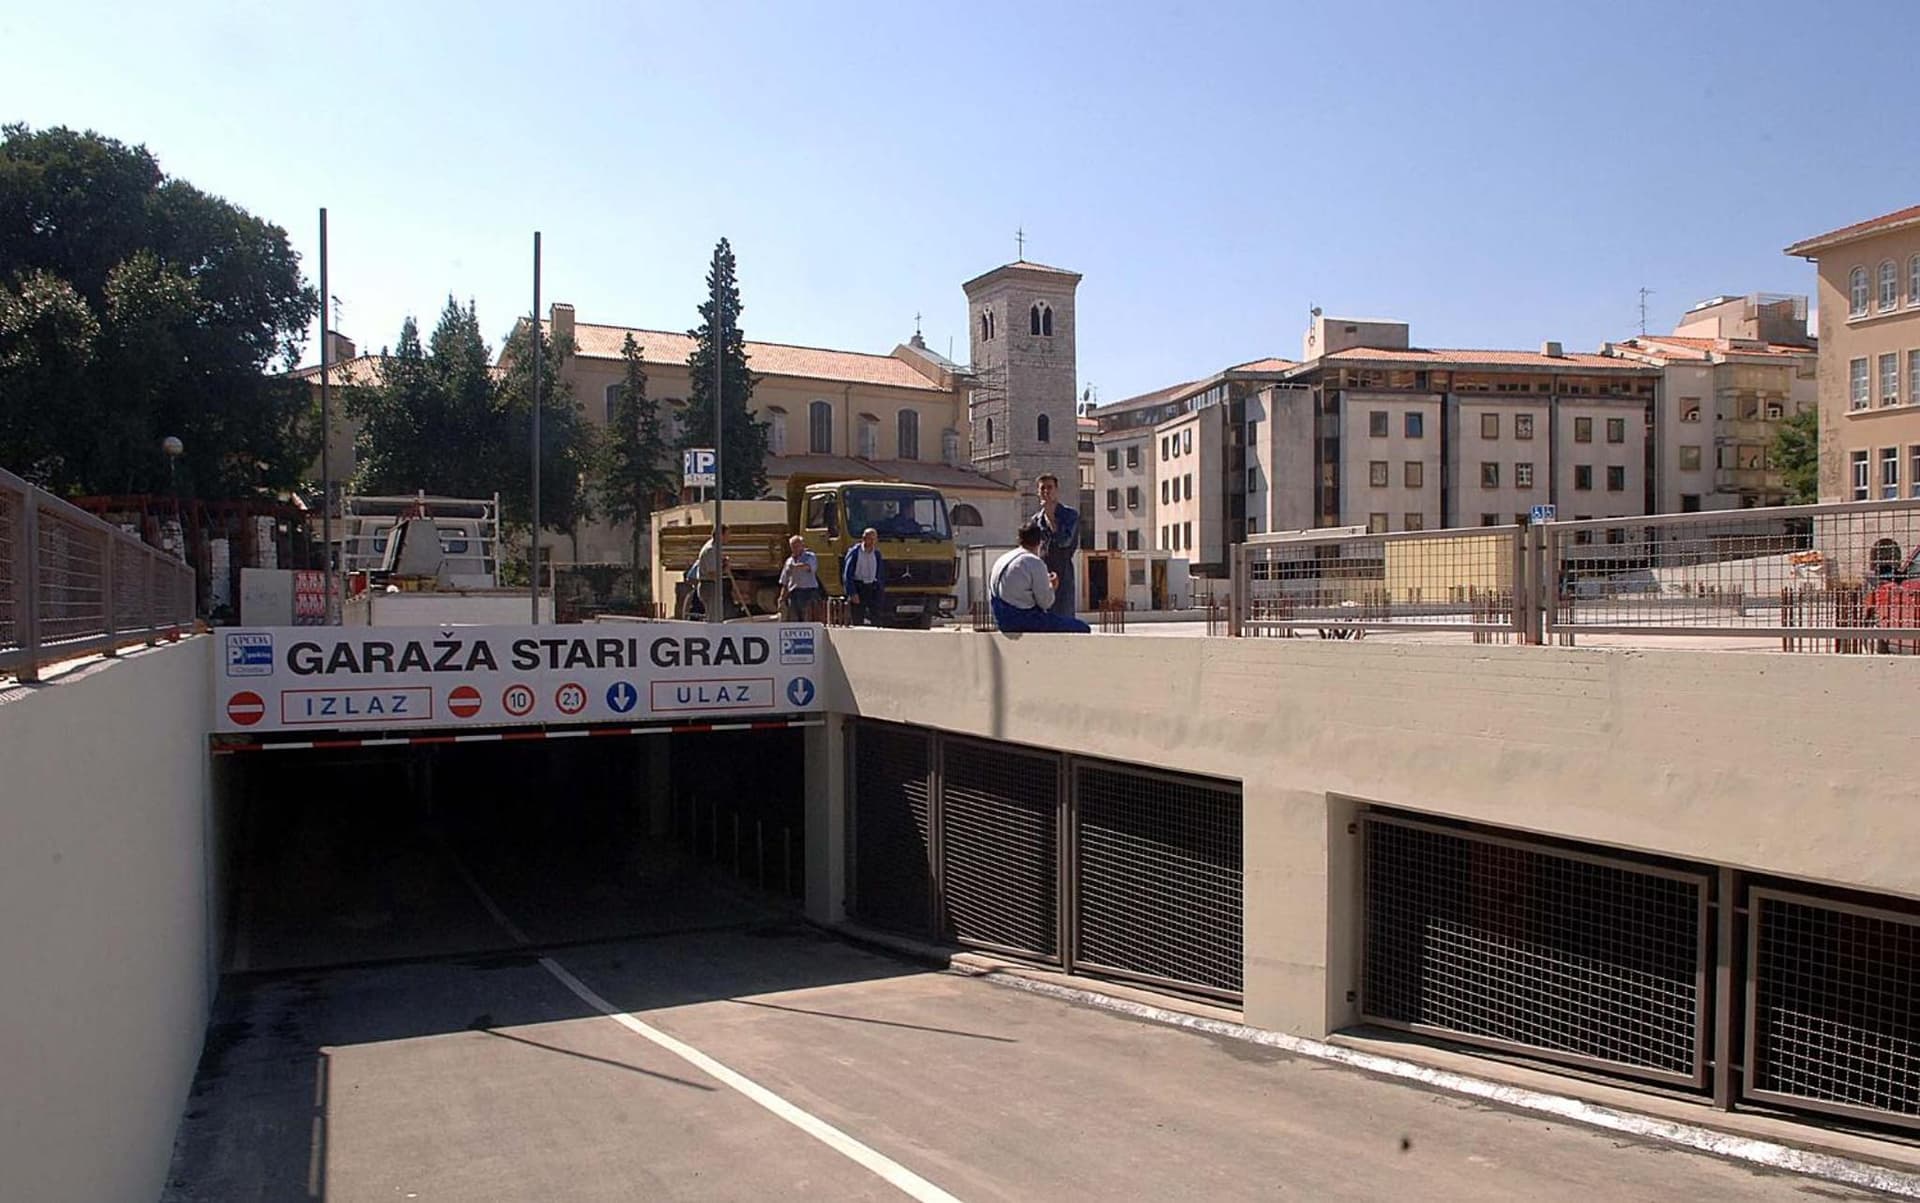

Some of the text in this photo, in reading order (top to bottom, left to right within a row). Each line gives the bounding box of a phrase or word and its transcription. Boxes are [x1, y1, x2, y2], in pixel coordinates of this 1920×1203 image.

[697, 452, 715, 473] P
[287, 631, 770, 675] GARAŽA STARI GRAD
[511, 692, 526, 708] 10
[676, 685, 751, 704] ULAZ
[306, 695, 408, 716] IZLAZ
